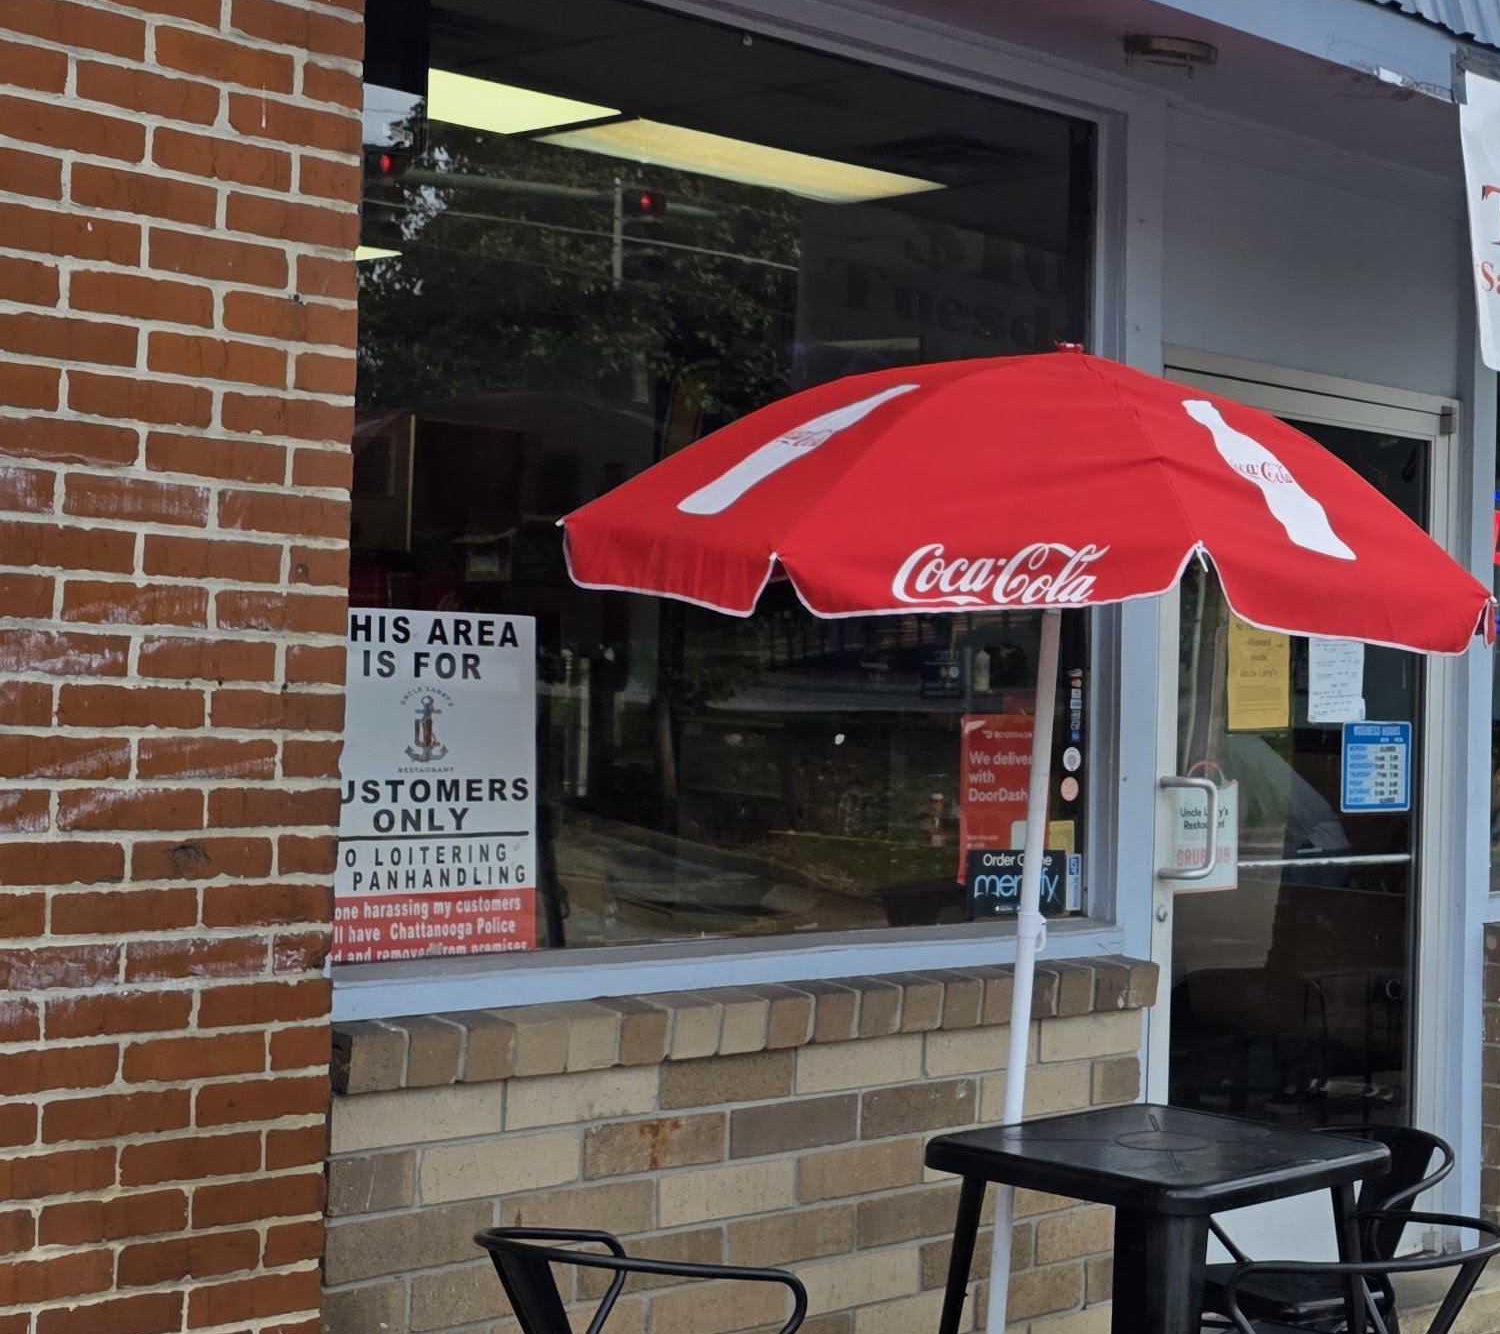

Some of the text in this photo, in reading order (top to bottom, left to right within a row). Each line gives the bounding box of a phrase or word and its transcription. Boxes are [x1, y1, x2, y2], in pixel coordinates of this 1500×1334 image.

[892, 542, 1111, 606] Coca-Cola
[349, 614, 519, 648] HIS AREA
[362, 650, 482, 680] IS FOR
[969, 751, 991, 765] We
[968, 769, 996, 783] with
[340, 777, 529, 804] USTOMERS
[968, 787, 1029, 802] DoorDash
[373, 807, 469, 833] ONLY
[1180, 806, 1229, 818] Uncle Ly's
[344, 843, 507, 868] O LOITERING
[983, 853, 1015, 867] Order
[1177, 846, 1231, 866] GRUBUB
[353, 864, 526, 892] PANHANDLING
[974, 867, 1059, 903] menfy
[334, 896, 522, 921] one harassing my customers
[349, 925, 381, 943] have
[390, 921, 473, 941] Chattanooga
[477, 916, 516, 934] Police
